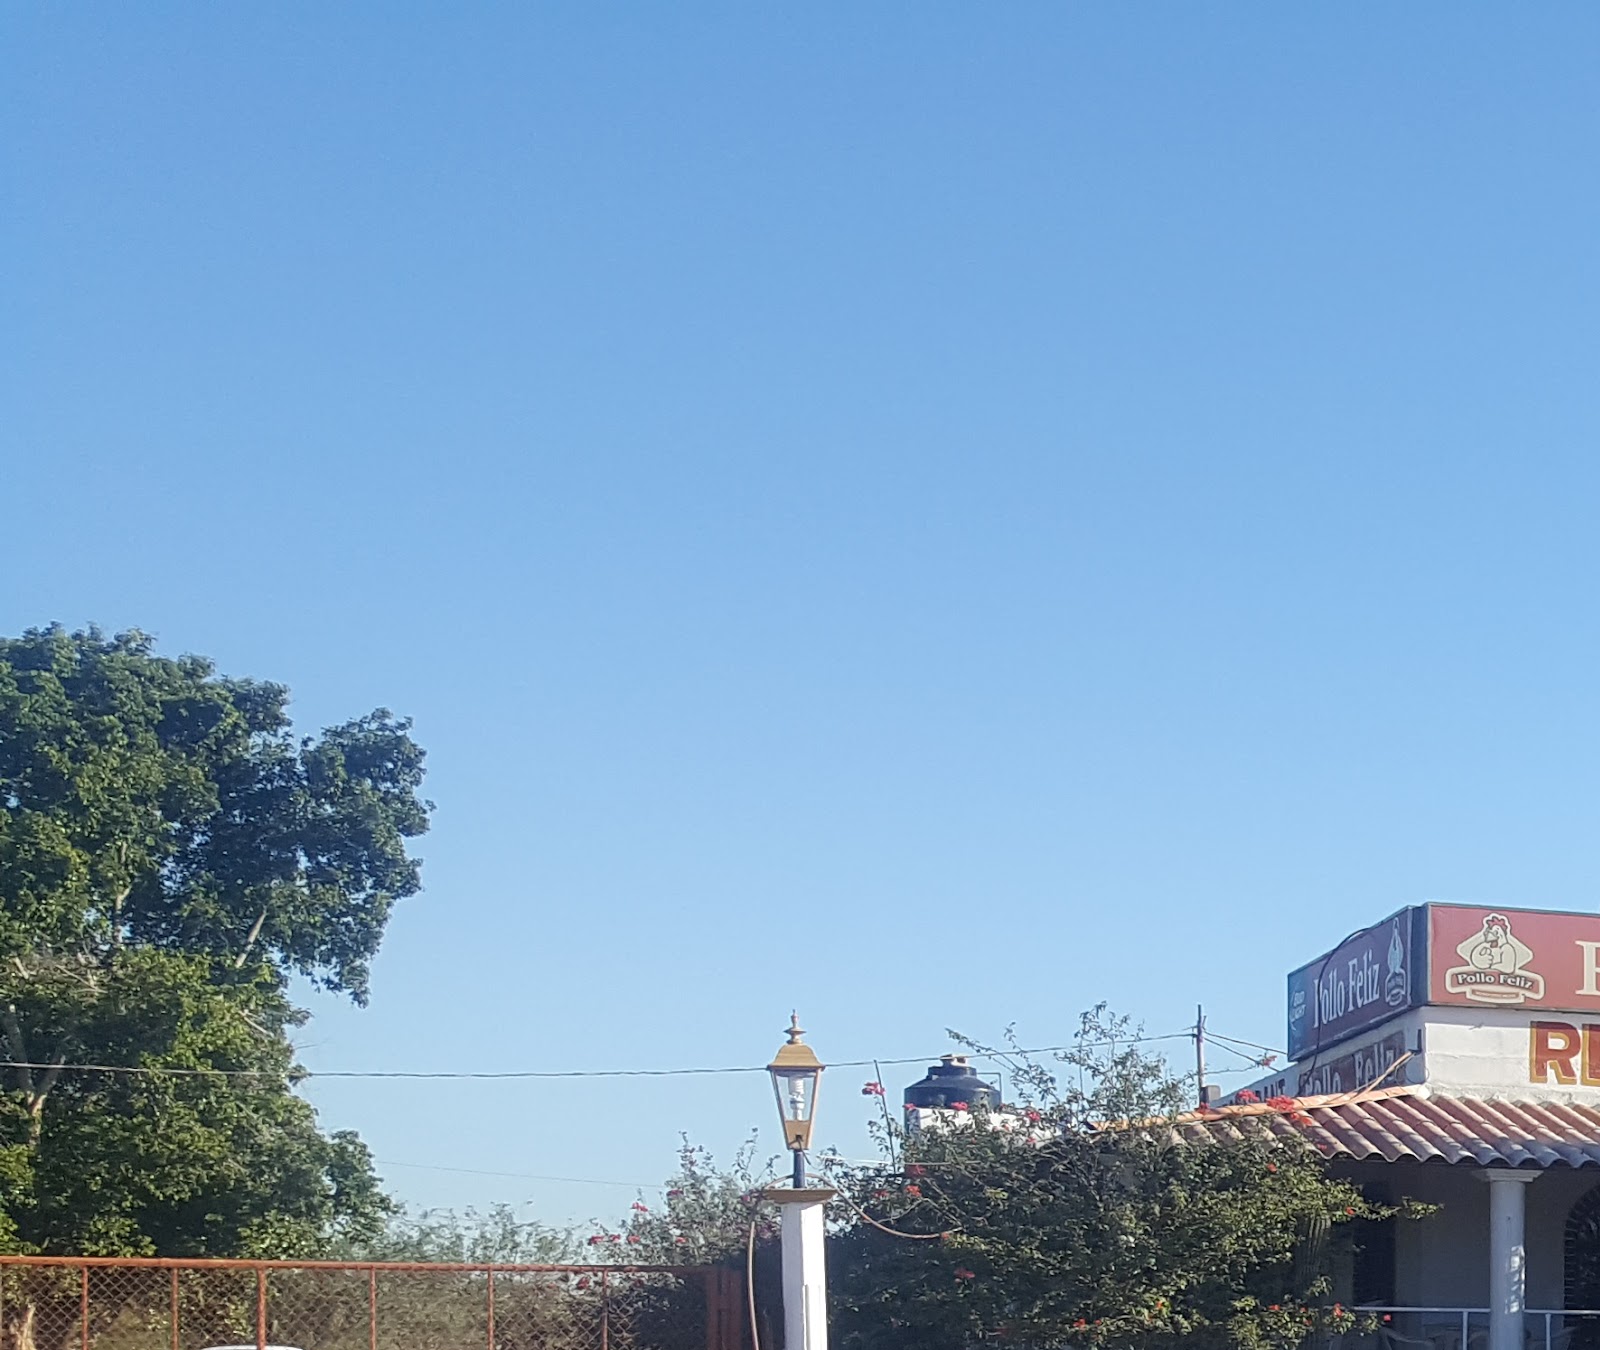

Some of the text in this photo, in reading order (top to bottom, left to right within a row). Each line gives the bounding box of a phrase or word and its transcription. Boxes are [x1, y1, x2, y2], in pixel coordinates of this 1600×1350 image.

[1348, 949, 1381, 1013] Feliz
[1457, 972, 1534, 989] Pollo Feliz
